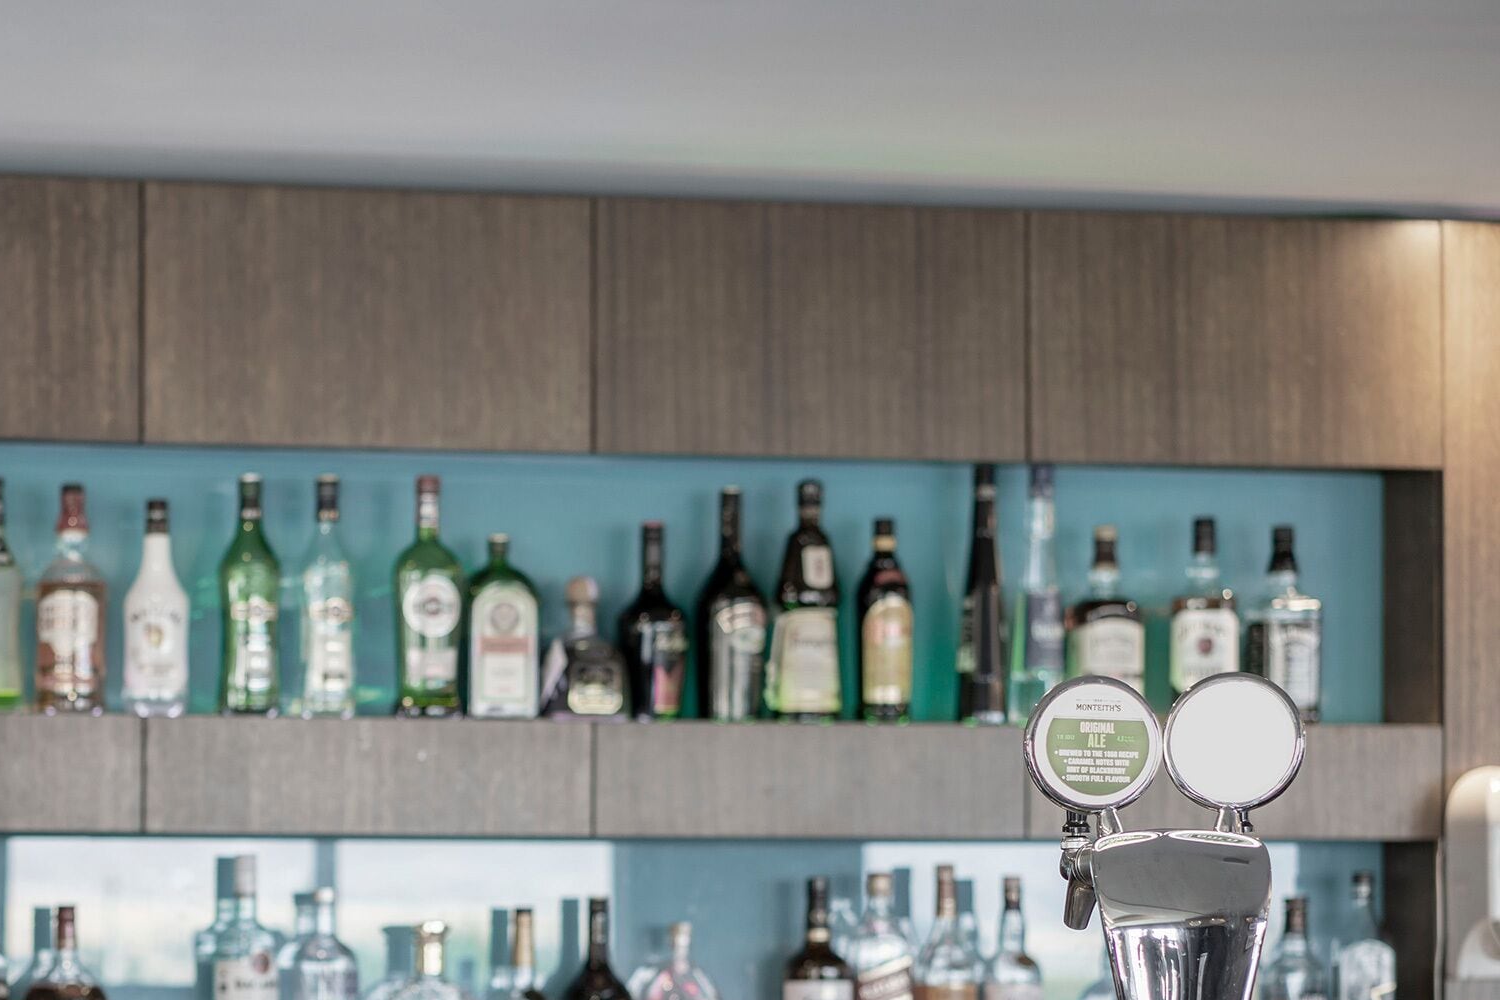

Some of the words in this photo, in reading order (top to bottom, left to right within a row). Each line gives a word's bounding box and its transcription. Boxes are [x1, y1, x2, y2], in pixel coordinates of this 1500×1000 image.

[1076, 703, 1122, 712] MONTEITH'S
[1080, 721, 1115, 734] ORIGINAL
[1087, 734, 1106, 748] ALE
[1092, 750, 1103, 758] THE
[1119, 751, 1139, 759] RECIPE
[1095, 758, 1114, 766] NOTES
[1080, 766, 1088, 774] OF
[1089, 767, 1126, 775] BLACKBERRY
[1066, 774, 1090, 782] SMOOTH
[1090, 775, 1104, 783] FULL
